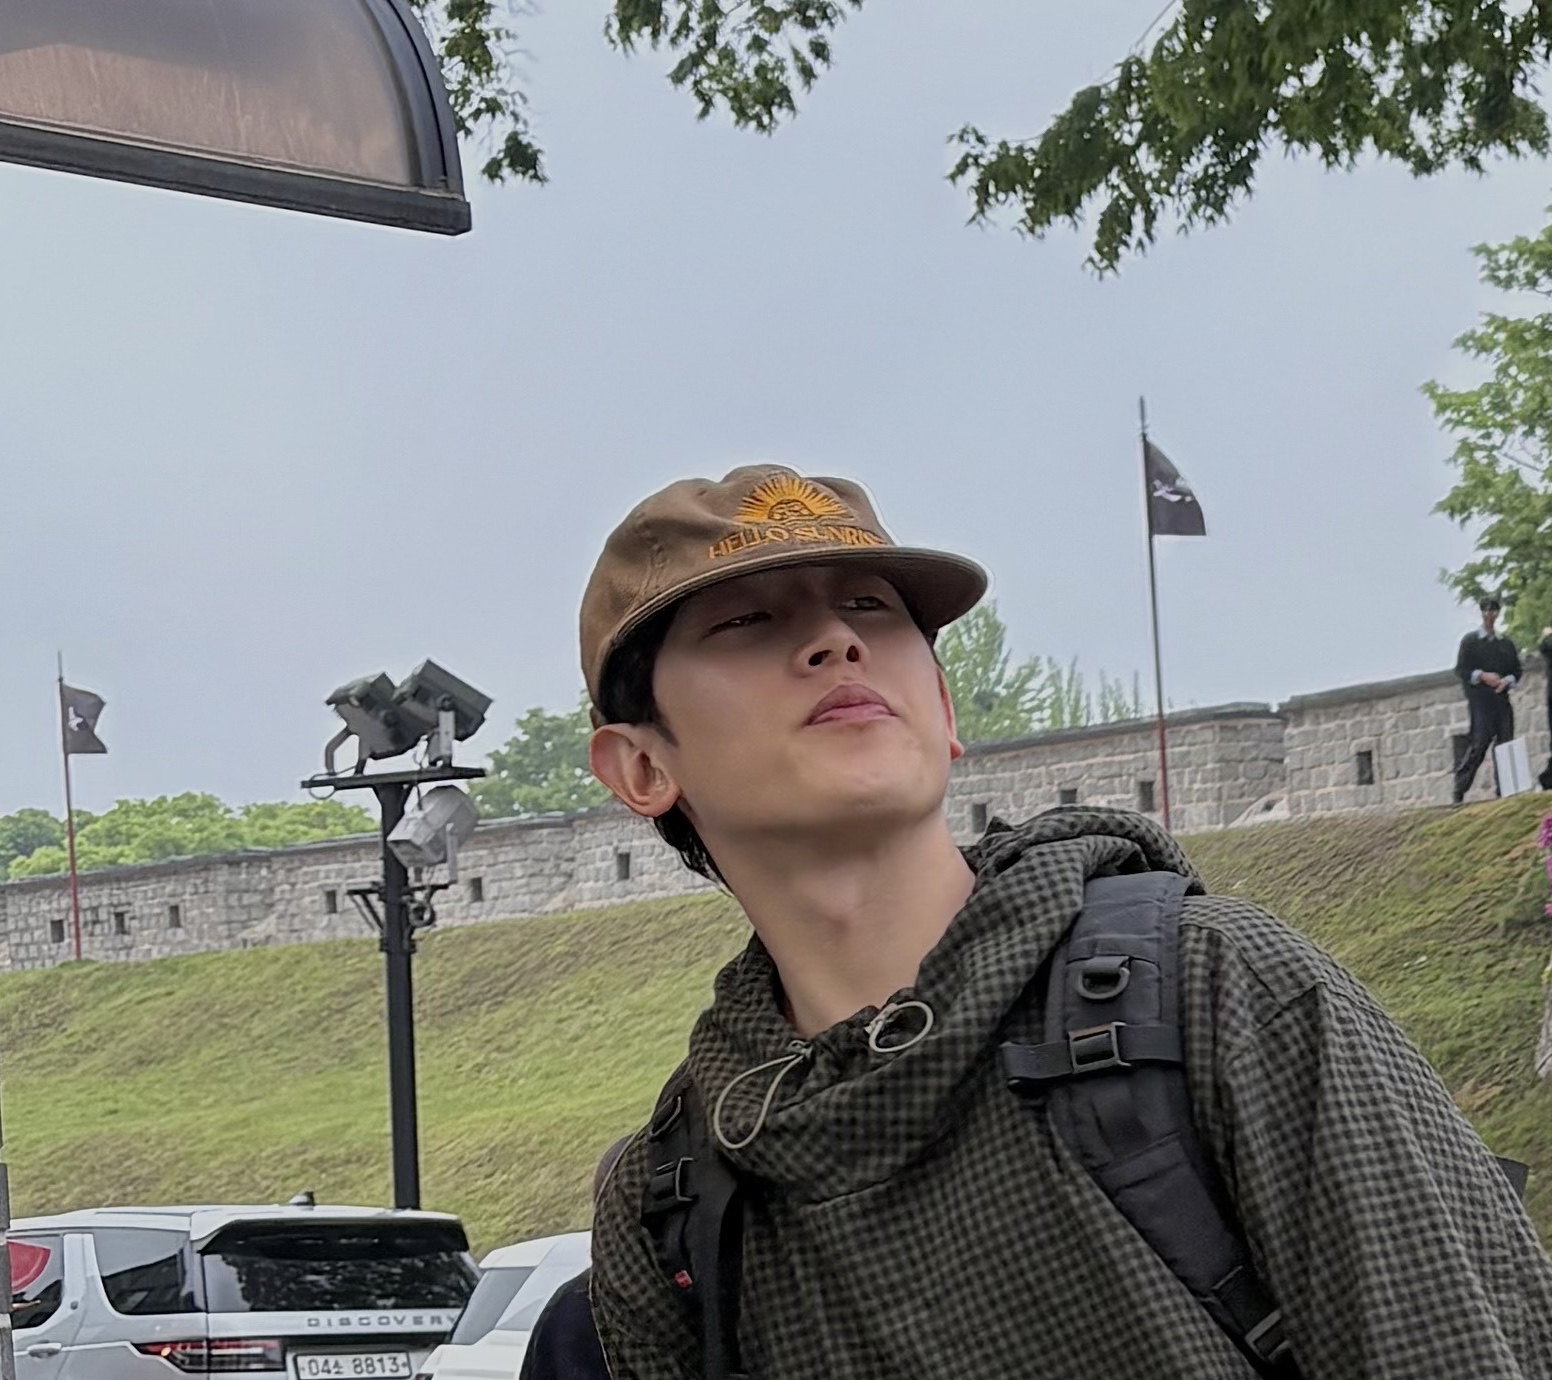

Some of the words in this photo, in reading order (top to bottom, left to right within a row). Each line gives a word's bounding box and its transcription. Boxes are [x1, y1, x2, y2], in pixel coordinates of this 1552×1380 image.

[708, 523, 790, 559] HELLO
[307, 1315, 456, 1328] DISCOVERY
[352, 1357, 400, 1375] 8813
